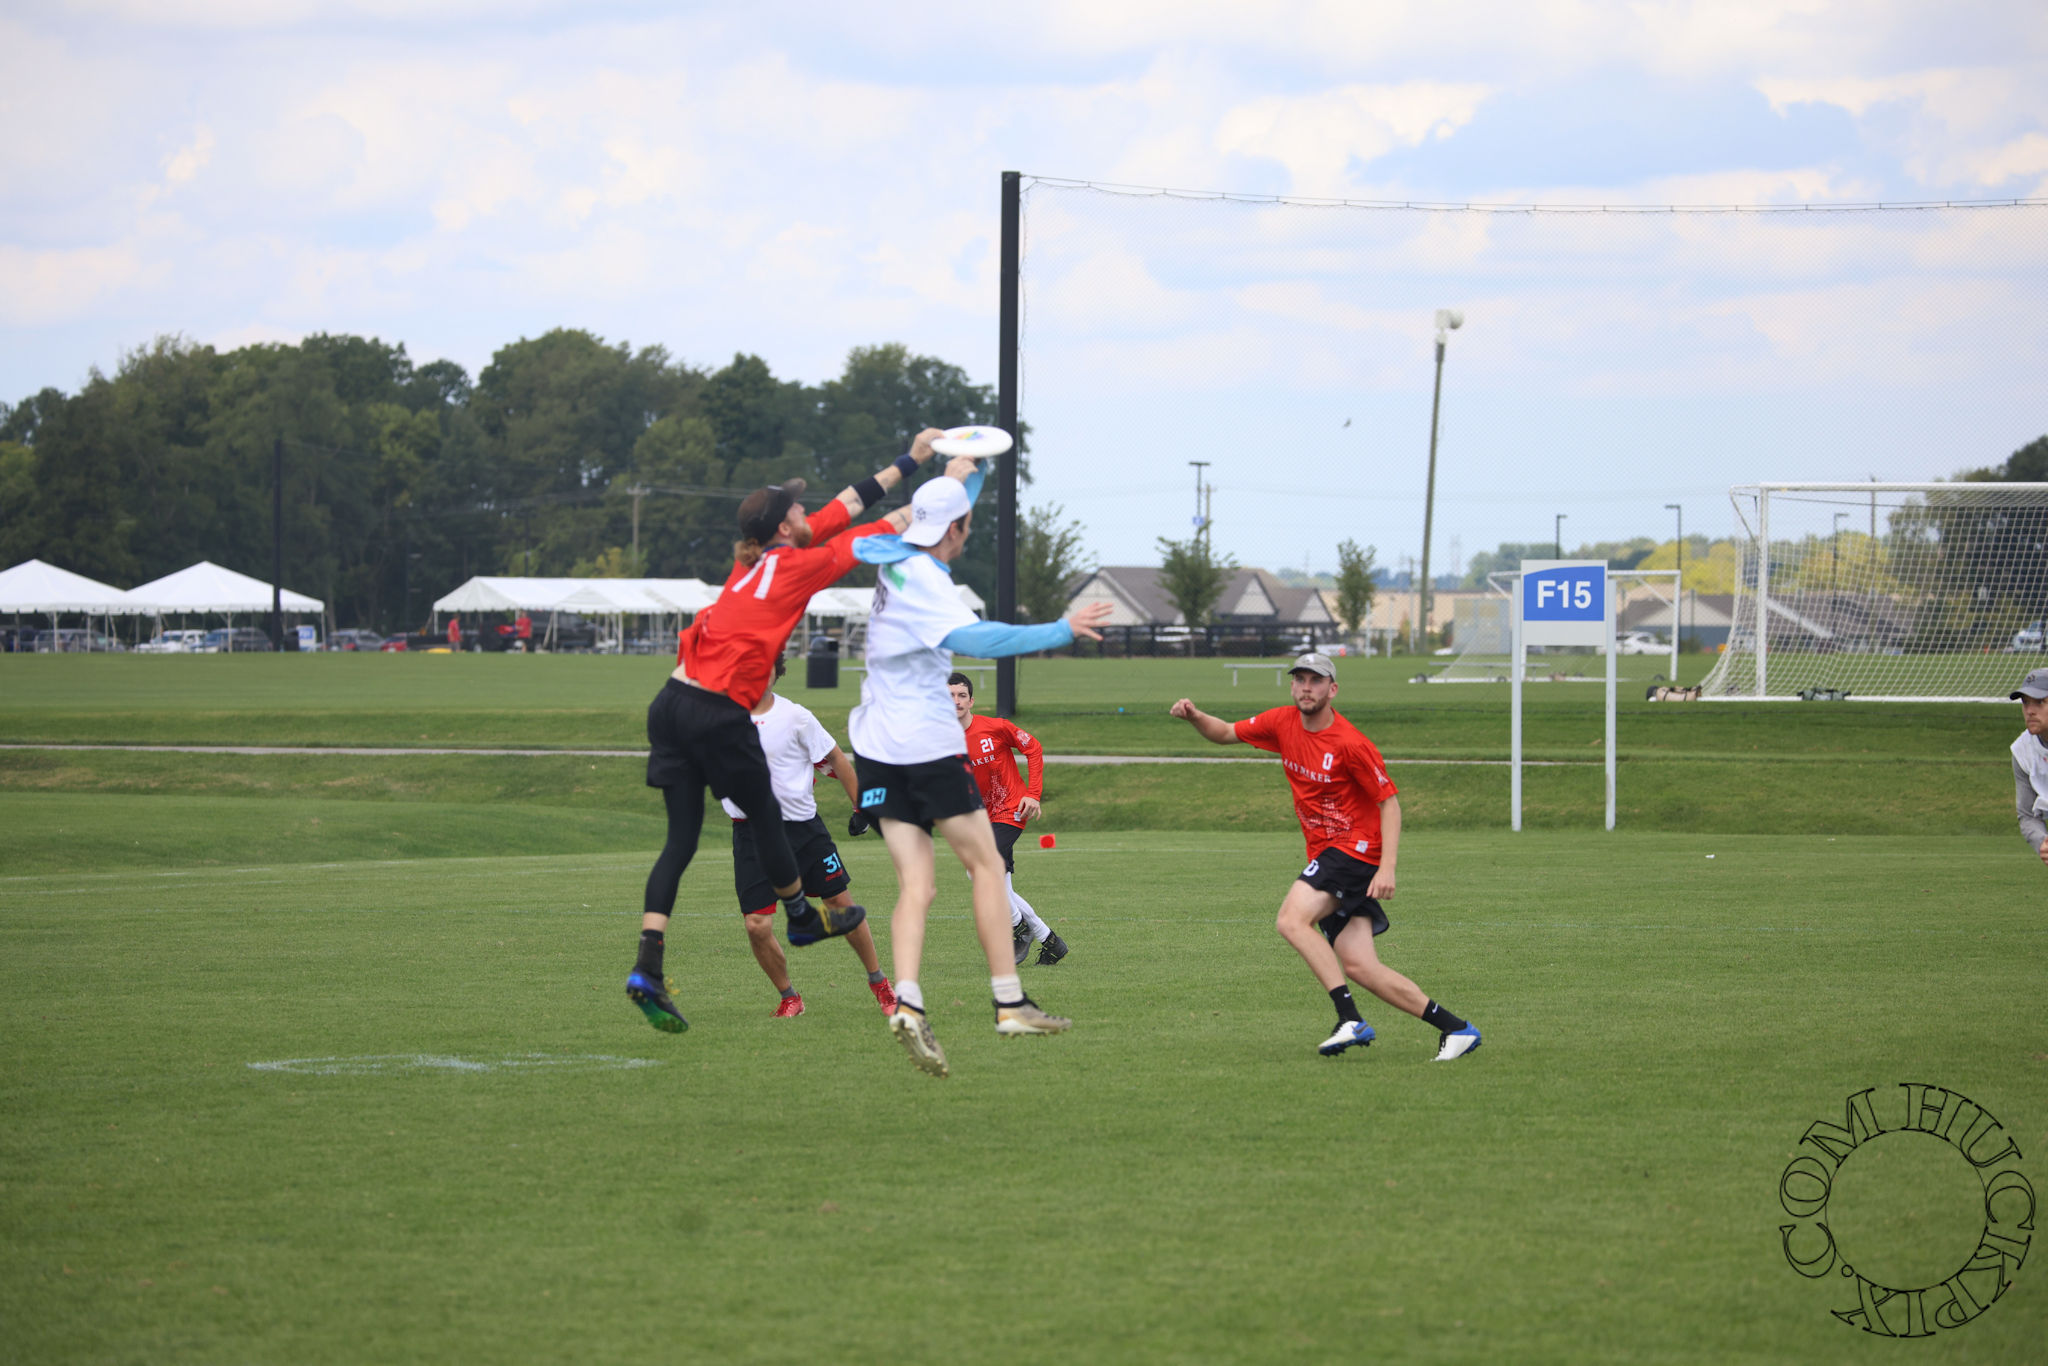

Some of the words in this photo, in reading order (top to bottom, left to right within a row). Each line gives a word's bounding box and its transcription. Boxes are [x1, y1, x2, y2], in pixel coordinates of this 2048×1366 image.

[1537, 580, 1592, 609] F15
[980, 737, 994, 753] 21
[823, 852, 841, 874] 31
